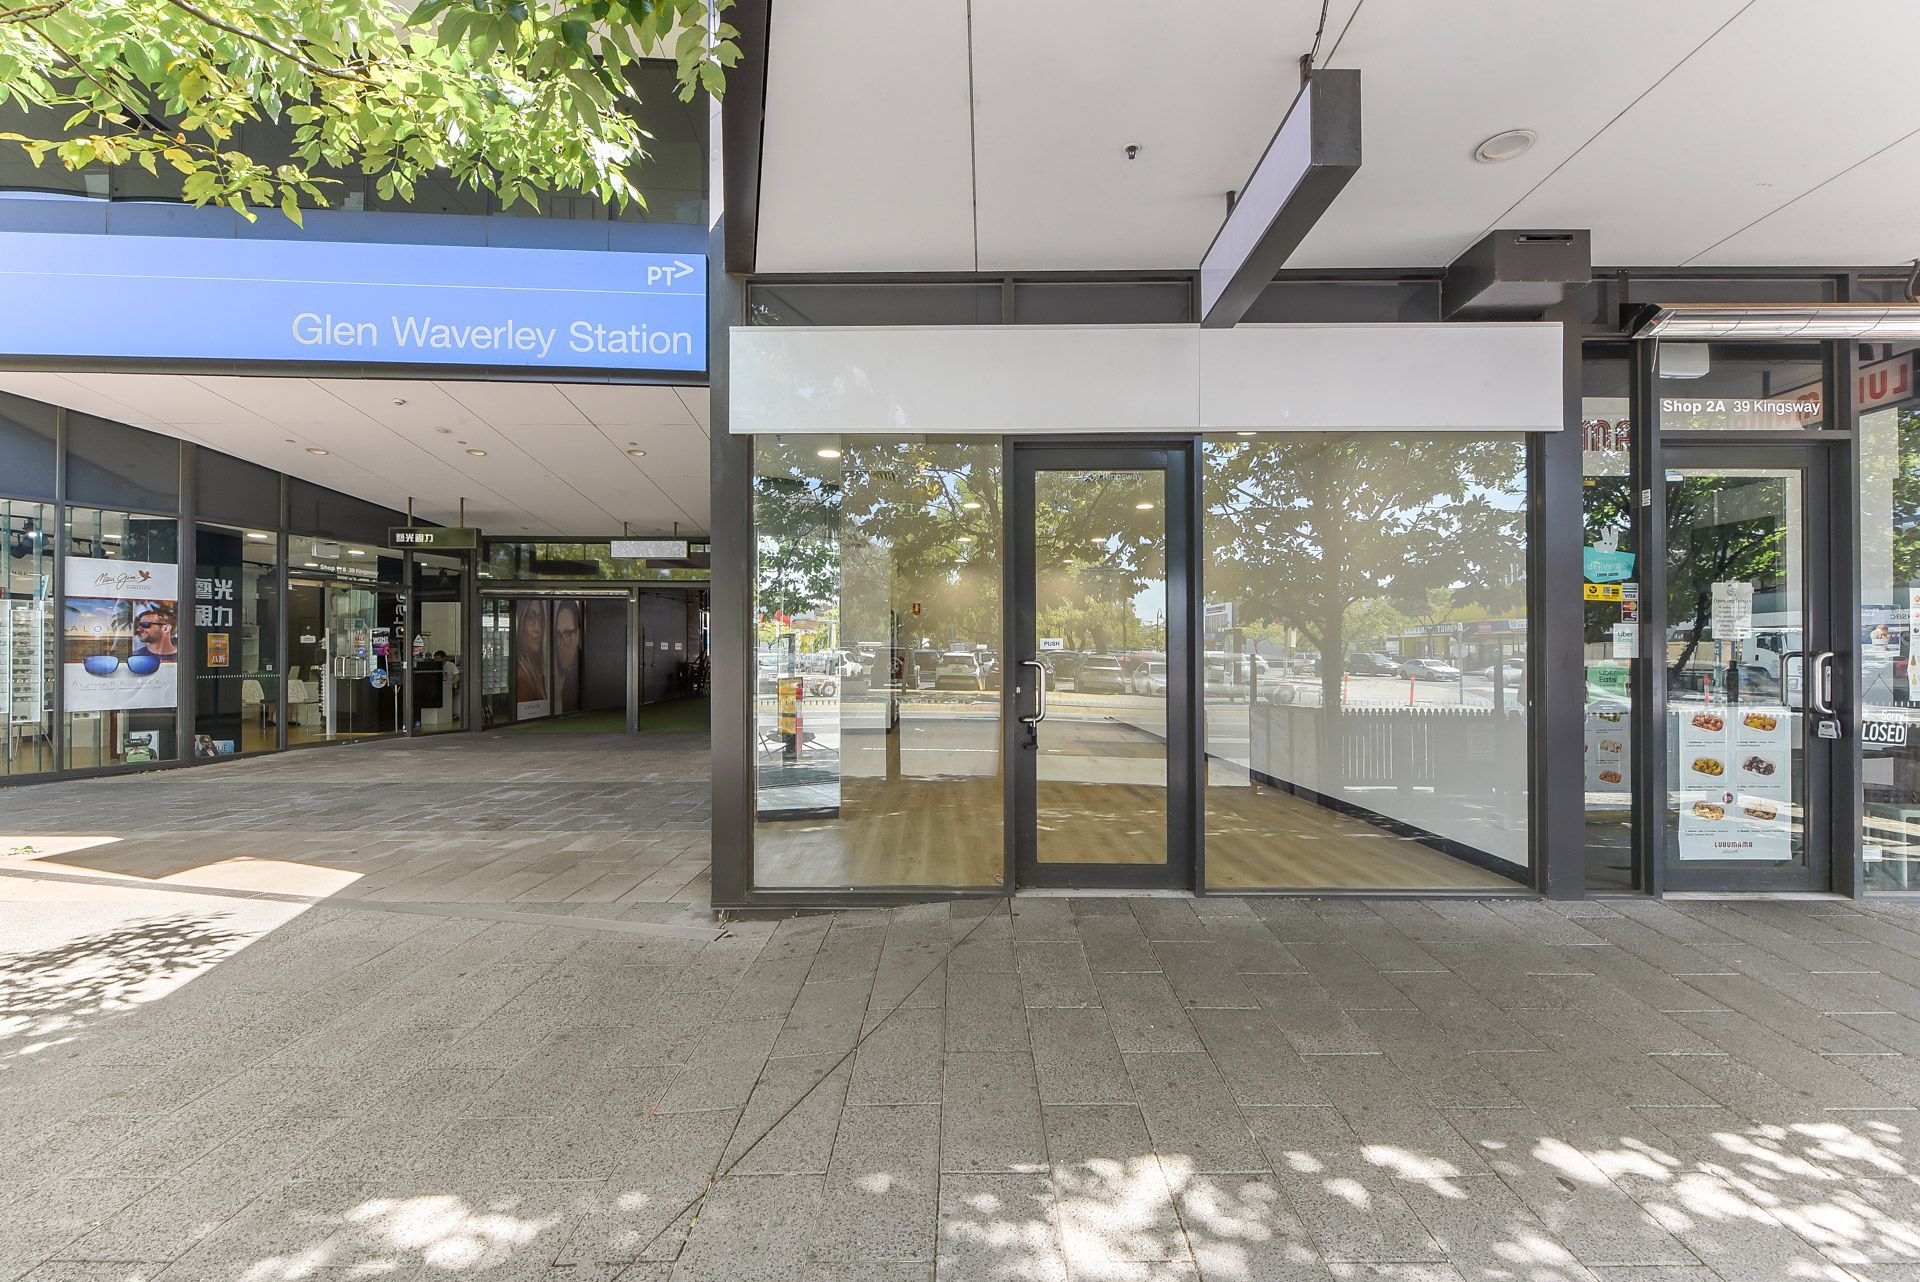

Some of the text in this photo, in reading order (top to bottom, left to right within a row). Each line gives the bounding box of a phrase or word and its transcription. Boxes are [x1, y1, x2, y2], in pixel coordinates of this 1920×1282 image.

[292, 312, 693, 359] Glen Waverley Station
[1663, 400, 1820, 416] Shop 2A 39 Kingsway
[320, 563, 336, 572] Shop
[70, 624, 128, 633] ALOHA
[1861, 722, 1905, 743] LOSED
